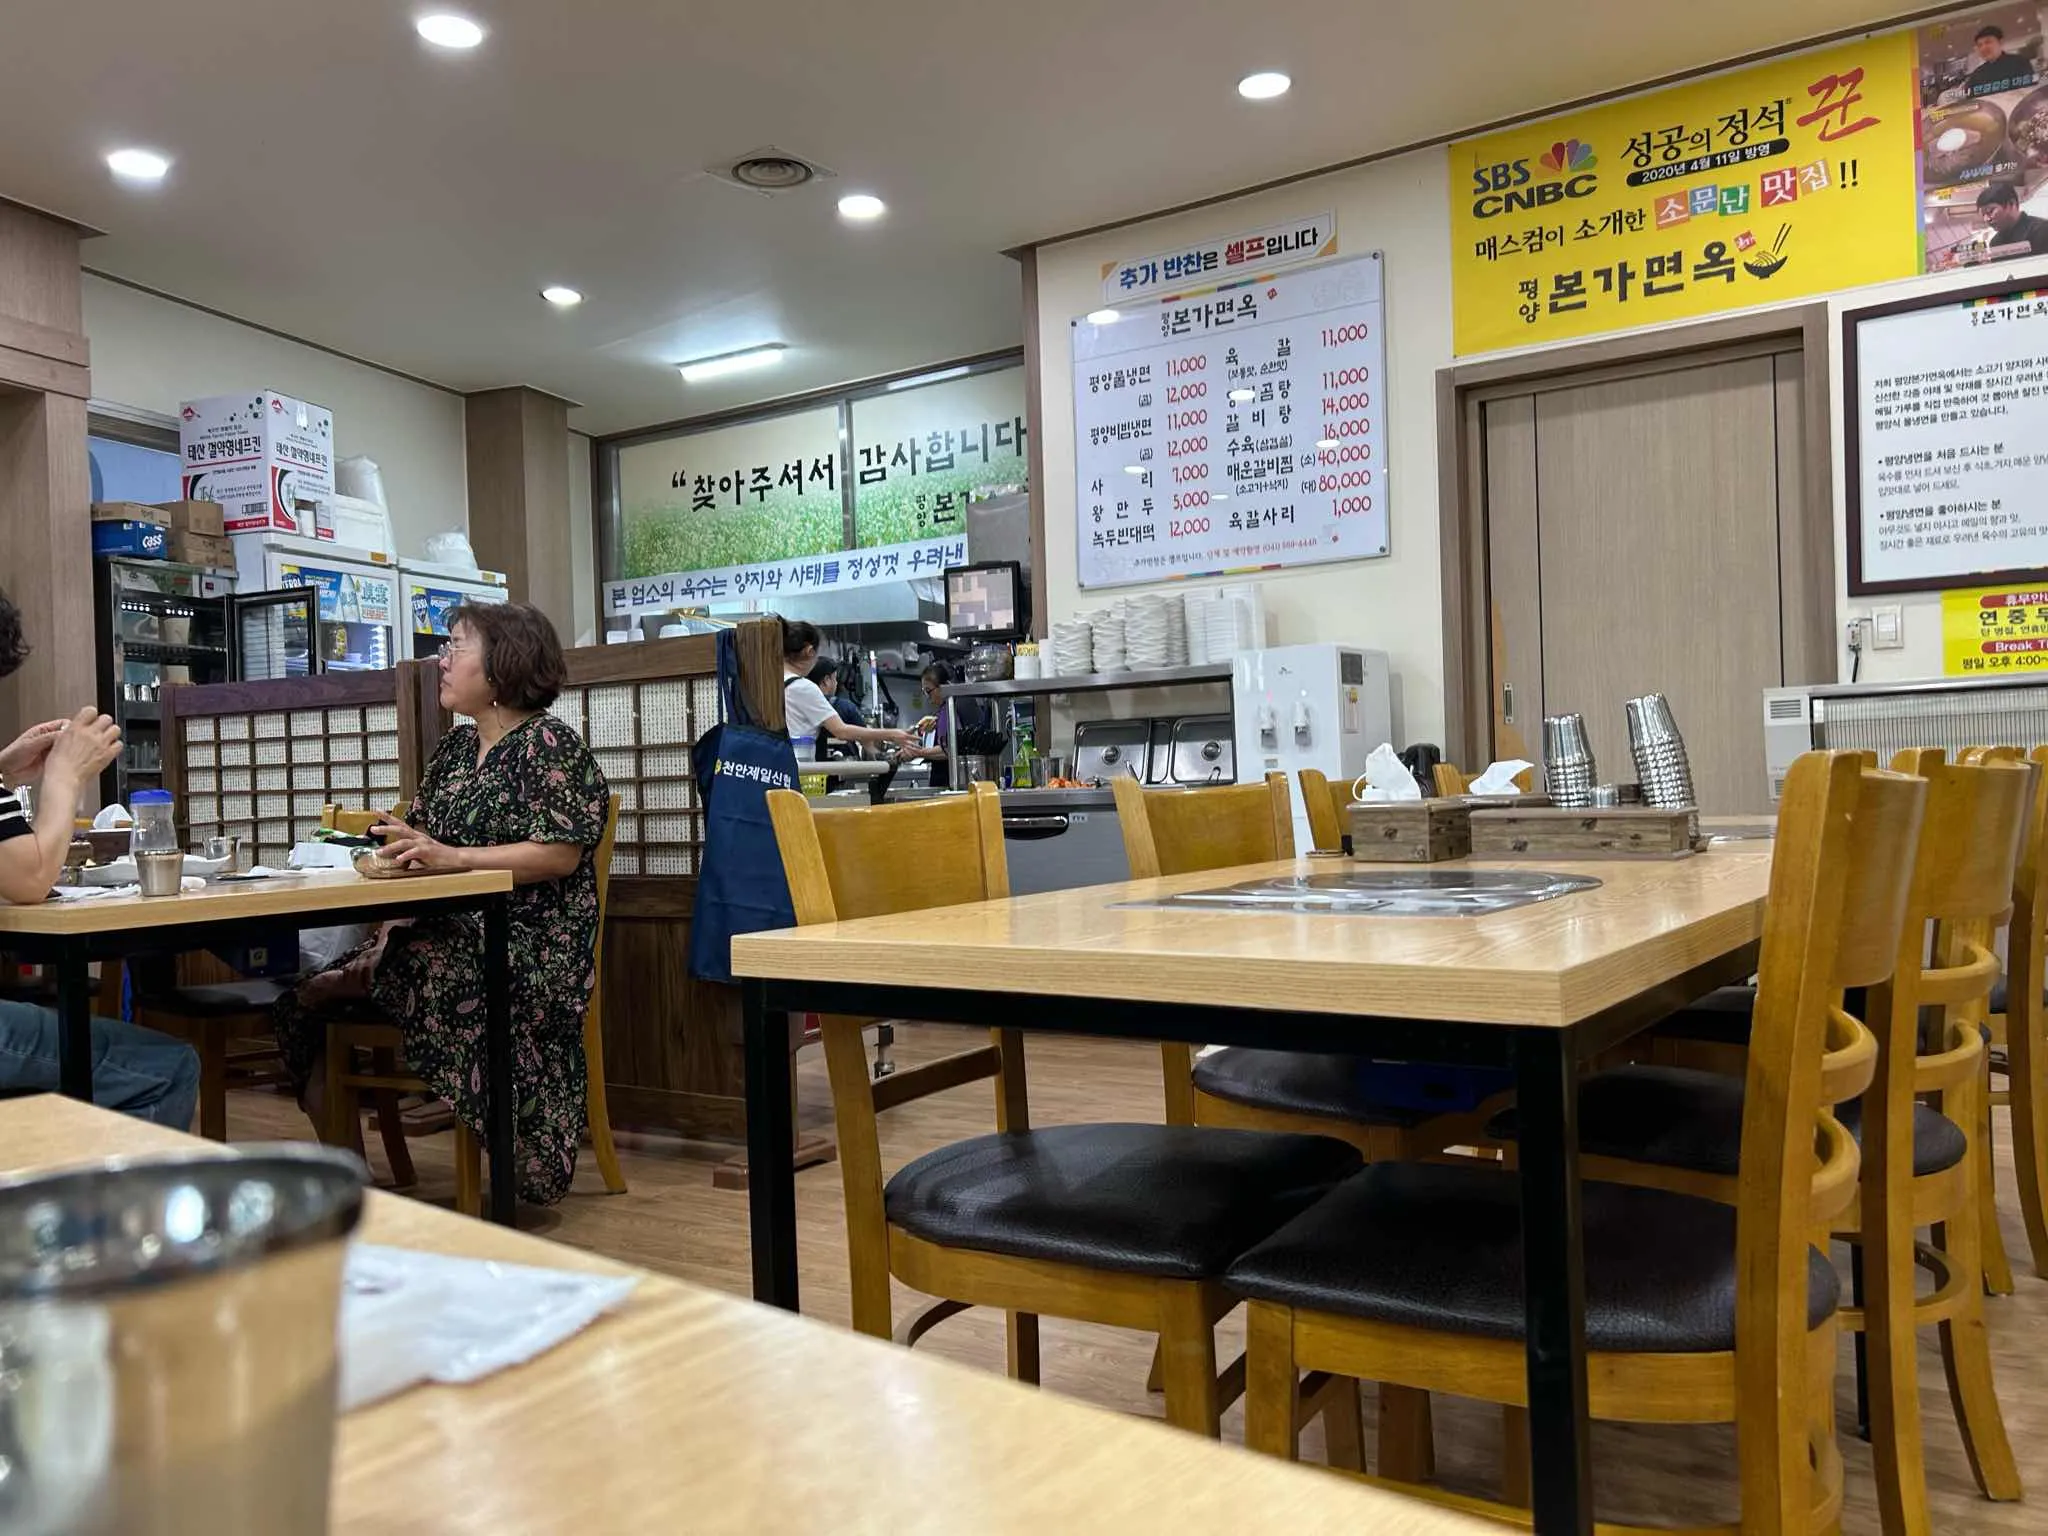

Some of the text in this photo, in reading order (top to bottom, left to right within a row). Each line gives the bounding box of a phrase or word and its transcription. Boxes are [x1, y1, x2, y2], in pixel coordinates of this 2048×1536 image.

[1796, 67, 1881, 142] 꾼
[1620, 99, 1787, 169] 성공의 정석
[1472, 158, 1530, 196] SBS
[1642, 144, 1771, 183] 2020년 4월 11일 방영
[1472, 174, 1598, 219] CNBC
[1475, 225, 1566, 263] 매스컴이
[1573, 208, 1647, 241] 소개한
[1655, 186, 1751, 230] 소문난
[1761, 160, 1832, 207] 맛집
[1119, 227, 1319, 290] 추가 반찬은 셀프입니다
[1518, 240, 1735, 323] 평양 본가면옥
[1171, 293, 1258, 335] 본가면옥
[1981, 302, 2048, 324] 본가면옥
[1321, 323, 1368, 347] 11,000
[1165, 355, 1207, 377] 11,000
[1323, 366, 1369, 390] 11,000
[1166, 381, 1207, 405] 12,000
[1321, 392, 1369, 416] 14,000
[1090, 408, 1208, 446] 평양비빔냉면 11,000
[1322, 418, 1370, 441] 16,000
[857, 415, 1028, 485] 감사합니다
[1167, 436, 1208, 458] 12,000
[1226, 444, 1371, 482] 매운갈비찜 (소) 40,000
[1300, 479, 1317, 494] (대)
[1318, 470, 1372, 494] 80,000
[1173, 490, 1210, 512] 5,000
[1332, 495, 1372, 518] 1,000
[1092, 517, 1210, 549] 녹두빈대떡 12,000
[611, 541, 964, 609] 본 업소의 육수는 양지와 사태를 정성껏 우려낸
[1995, 641, 2033, 653] Break
[722, 760, 792, 791] 천안제일신협
